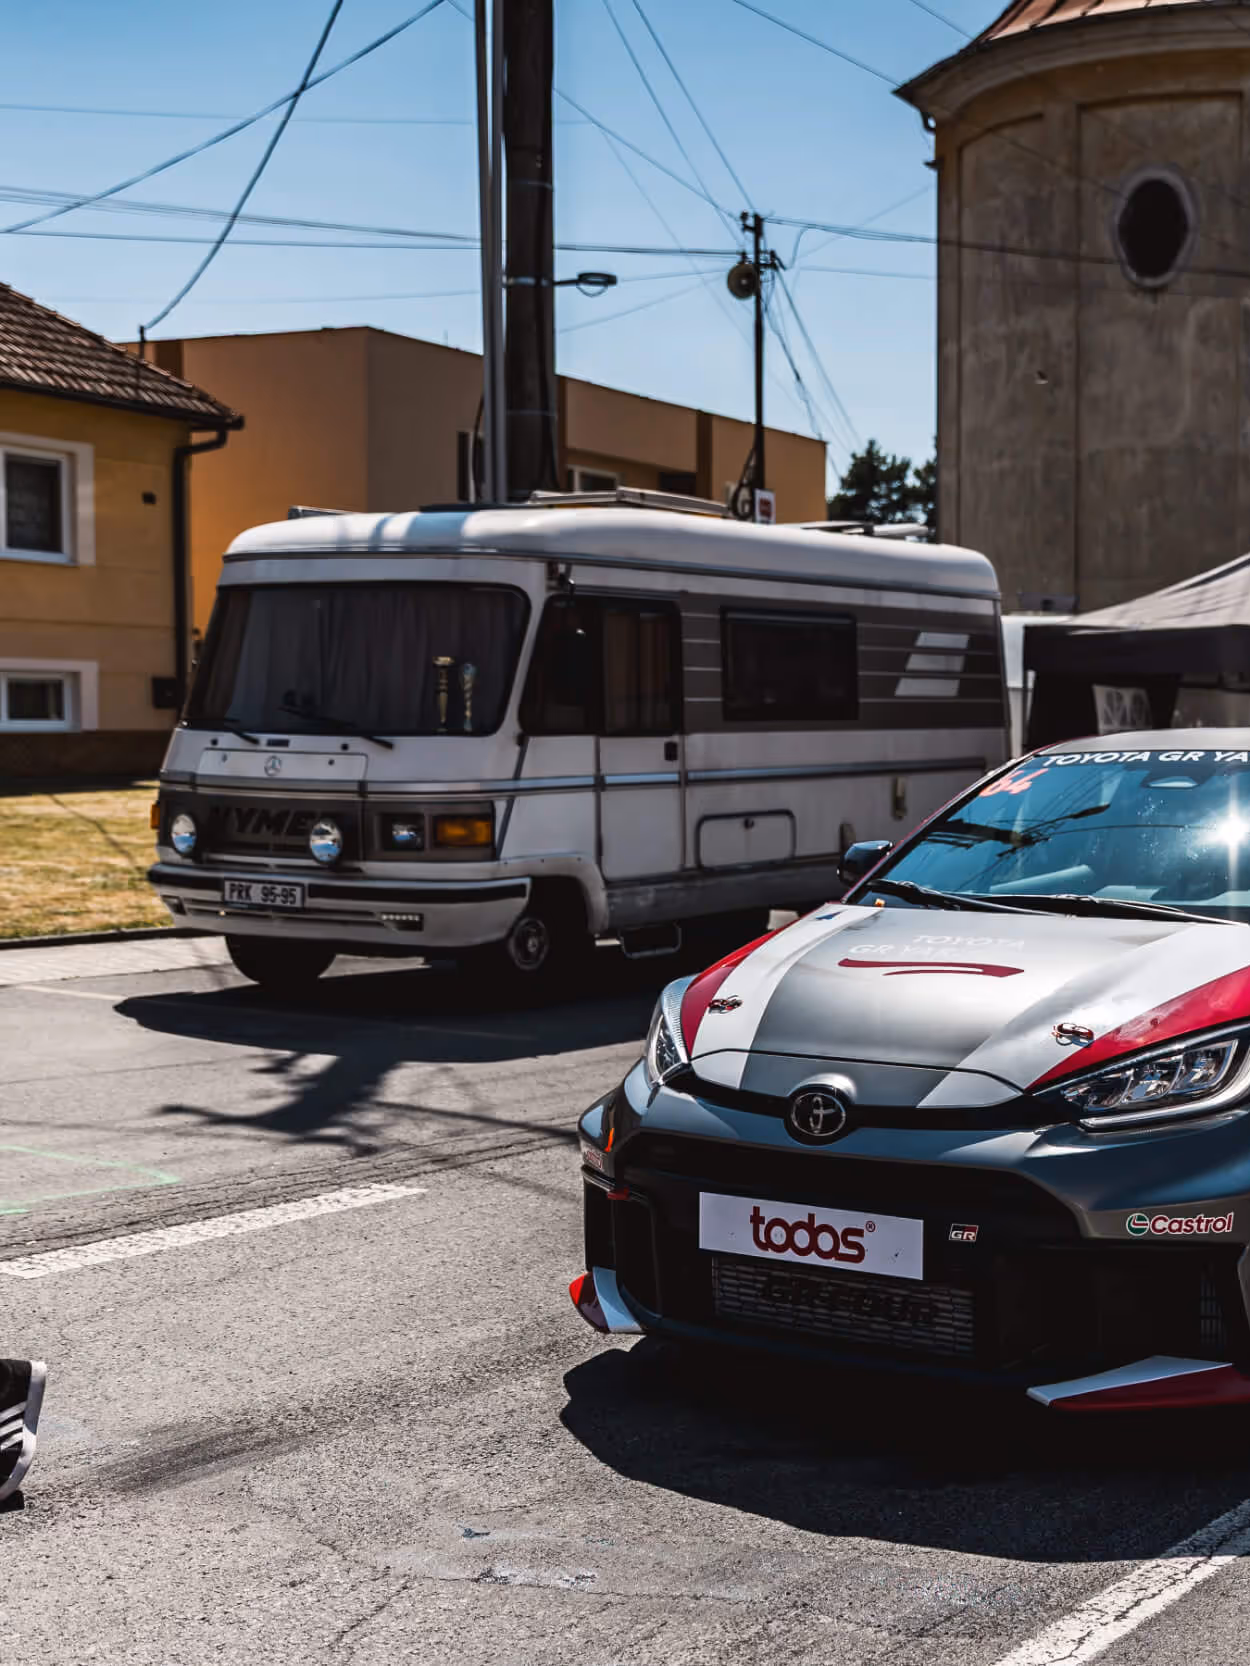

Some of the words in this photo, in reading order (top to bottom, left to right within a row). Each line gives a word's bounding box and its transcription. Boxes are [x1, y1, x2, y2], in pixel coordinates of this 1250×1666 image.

[1043, 752, 1150, 766] TOYOTA
[1158, 752, 1205, 762] GR
[229, 883, 252, 901] PRK
[260, 886, 297, 905] 95-95
[1150, 1202, 1235, 1235] Castrol
[951, 1229, 976, 1241] GR
